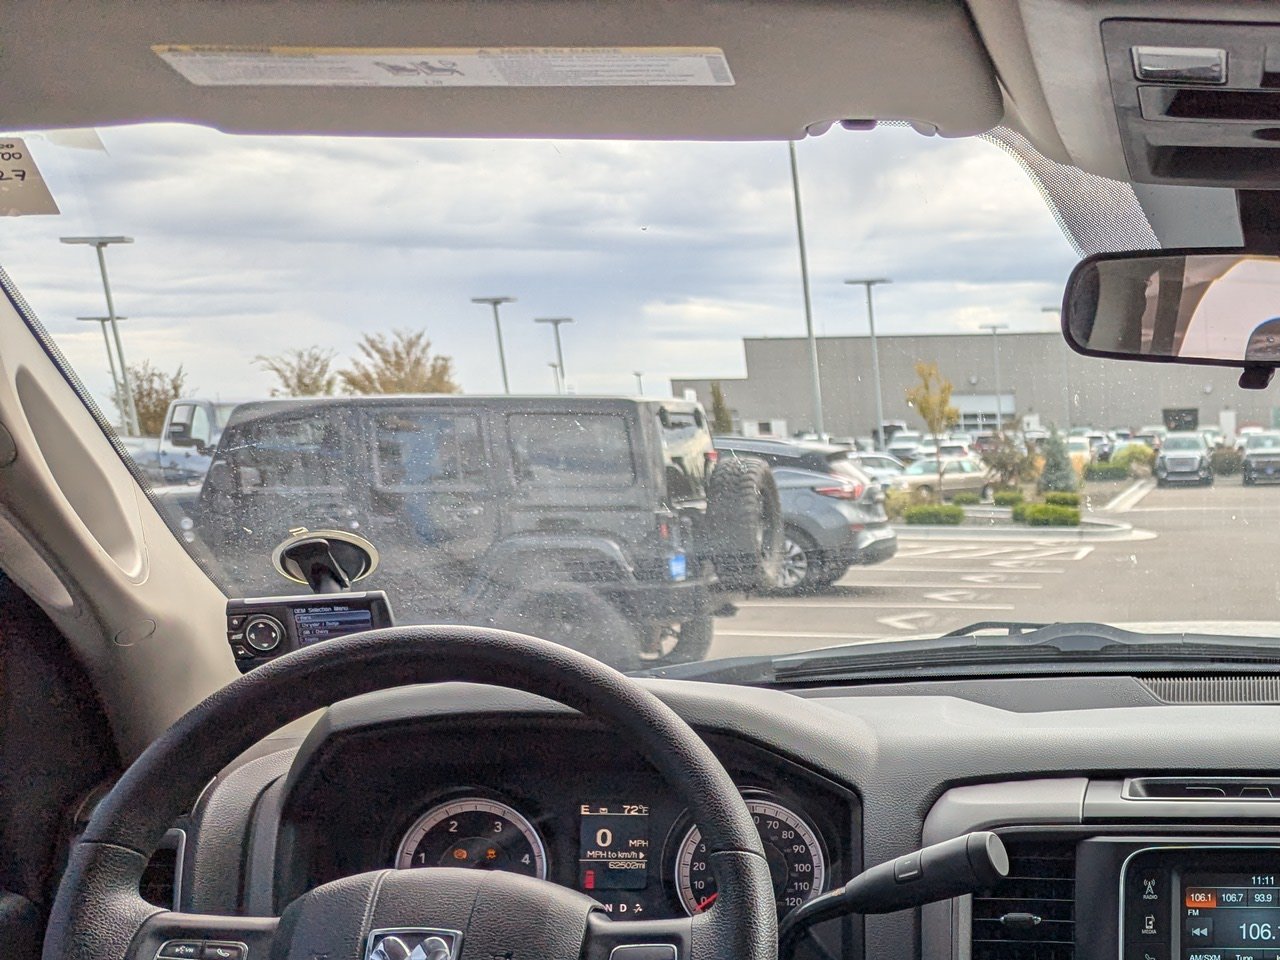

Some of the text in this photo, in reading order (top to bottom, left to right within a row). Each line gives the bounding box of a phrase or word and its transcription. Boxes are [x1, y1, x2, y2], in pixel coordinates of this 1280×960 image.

[581, 805, 590, 814] E
[449, 821, 457, 832] 2
[494, 822, 502, 832] 3
[766, 820, 779, 830] 70
[596, 828, 612, 847] 0
[781, 830, 795, 839] 80
[792, 845, 806, 854] 90
[418, 852, 425, 864] 1
[521, 853, 531, 865] 4
[618, 851, 637, 859] km/h
[693, 862, 706, 871] 20
[794, 863, 812, 873] 100
[694, 880, 705, 889] 10
[1251, 876, 1275, 885] 11:11
[793, 881, 810, 891] 110
[784, 896, 803, 906] 120
[1190, 893, 1212, 902] 106.1
[1221, 894, 1244, 903] 106.7
[1254, 894, 1273, 903] 93.9
[619, 904, 627, 912] D
